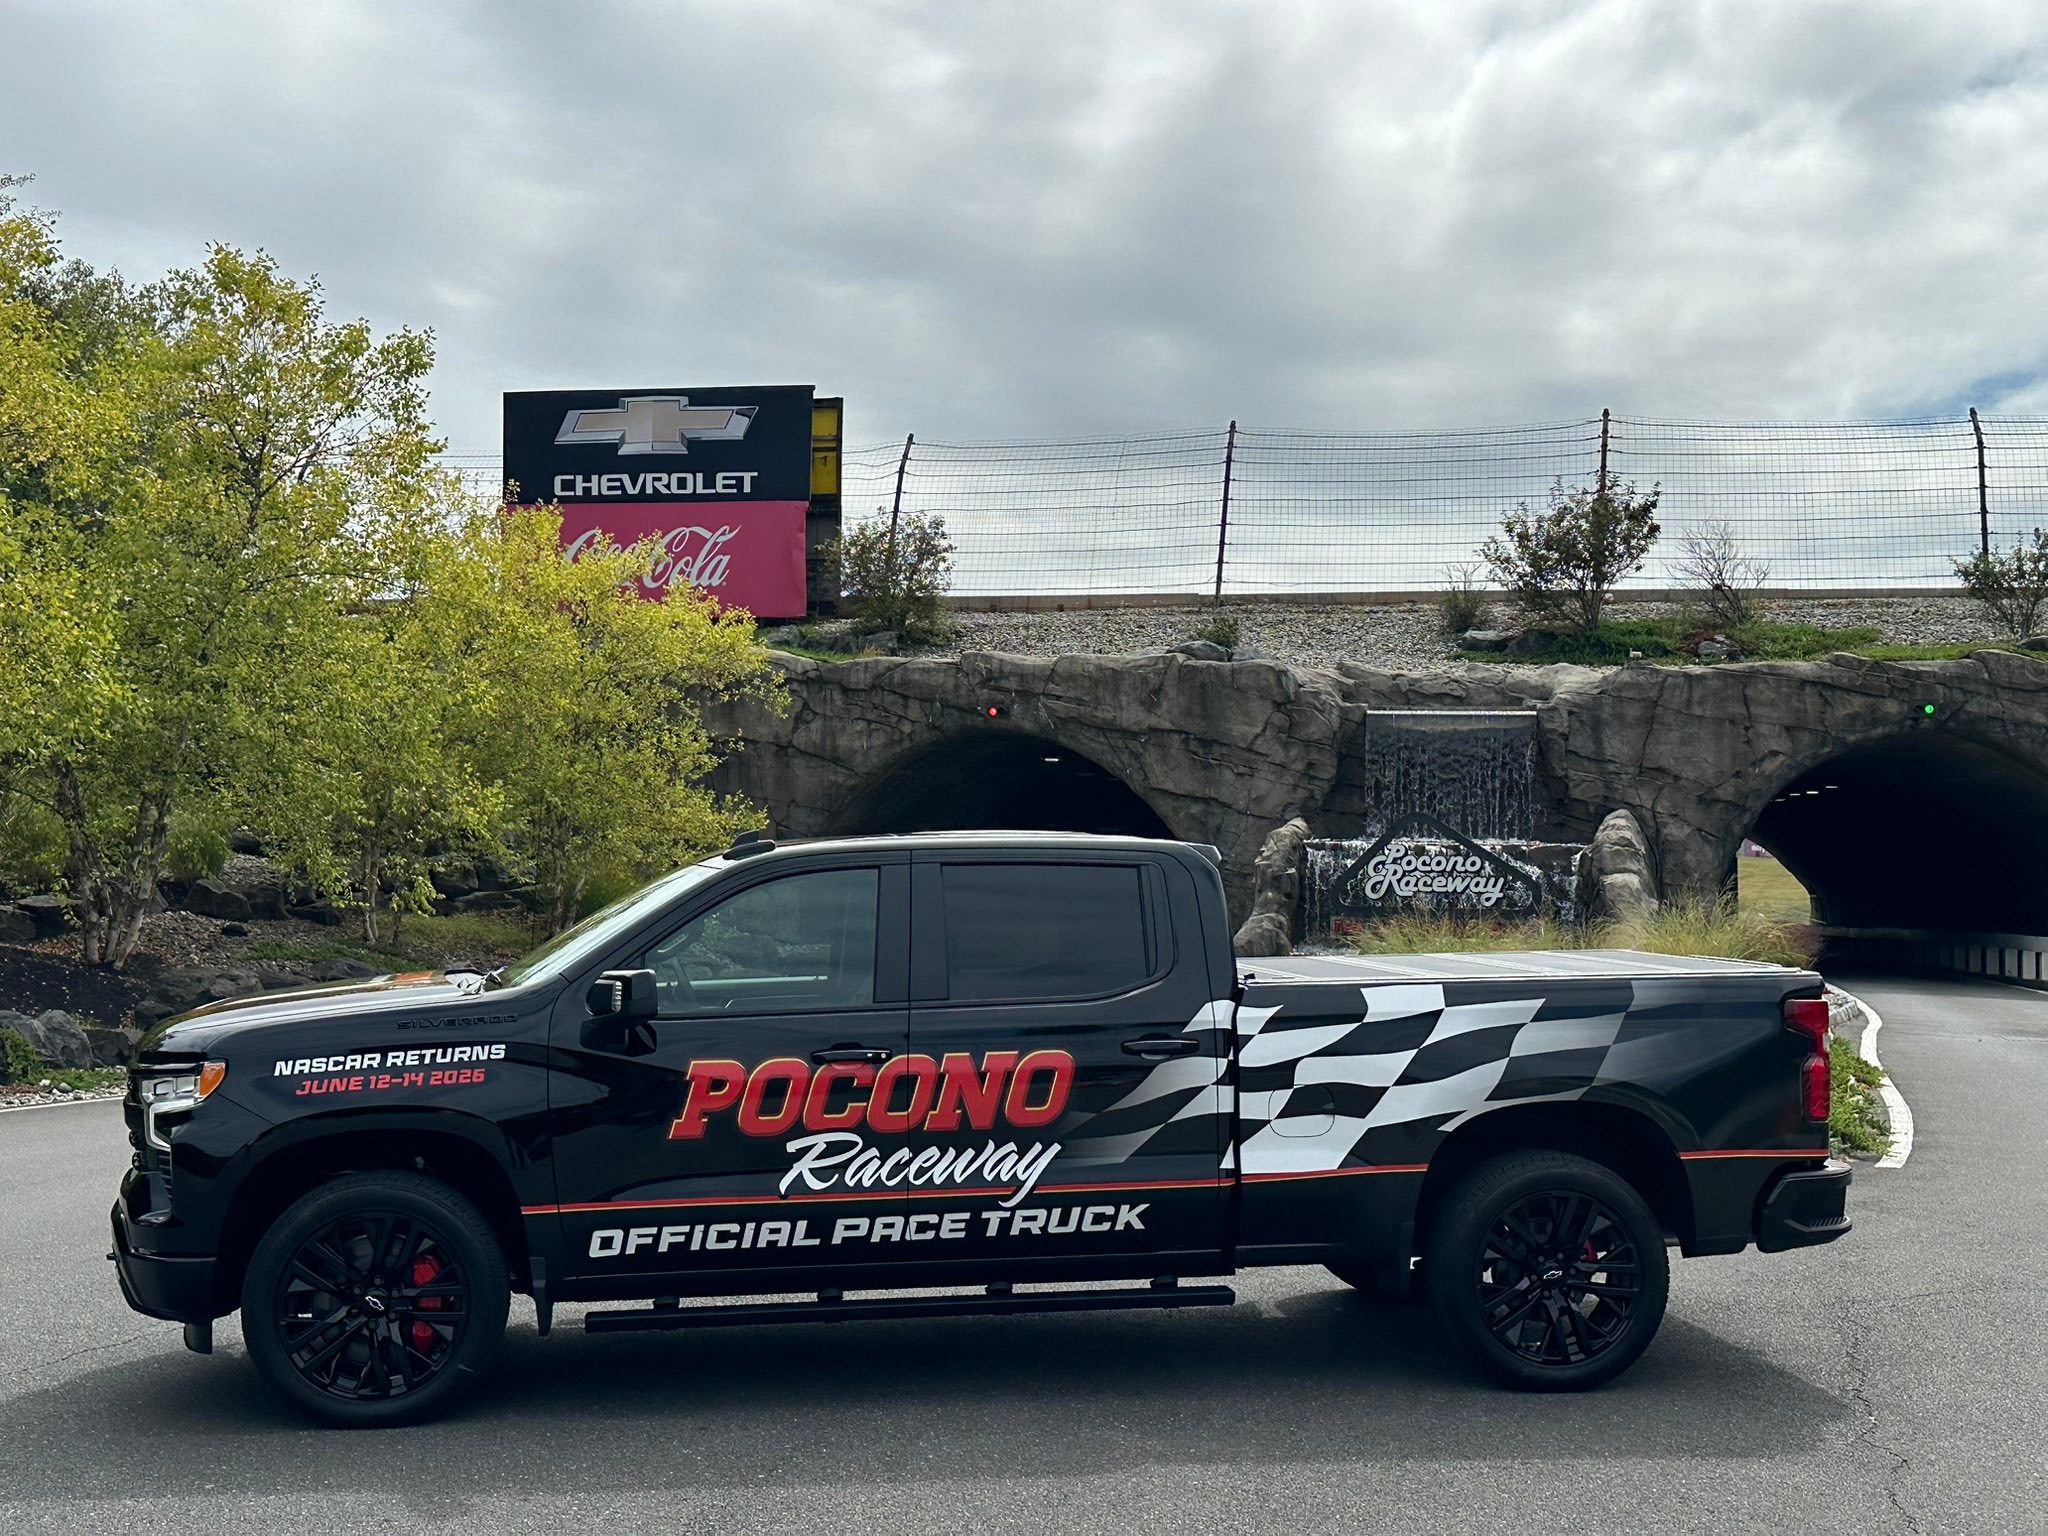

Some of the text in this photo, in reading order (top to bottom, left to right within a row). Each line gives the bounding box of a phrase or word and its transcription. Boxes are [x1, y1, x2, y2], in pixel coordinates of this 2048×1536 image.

[554, 472, 758, 496] CHEVROLET
[1367, 844, 1482, 876] Pocono
[1365, 864, 1505, 907] Raceway
[397, 1015, 517, 1030] SILVERADO
[273, 1044, 507, 1077] NASCAR RETURNS
[295, 1069, 486, 1095] JUNE 12-14 2026
[667, 1049, 1075, 1140] POCONO
[778, 1132, 1062, 1208] Raceway
[588, 1204, 1151, 1259] OFFICIAL PACE TRUCK
